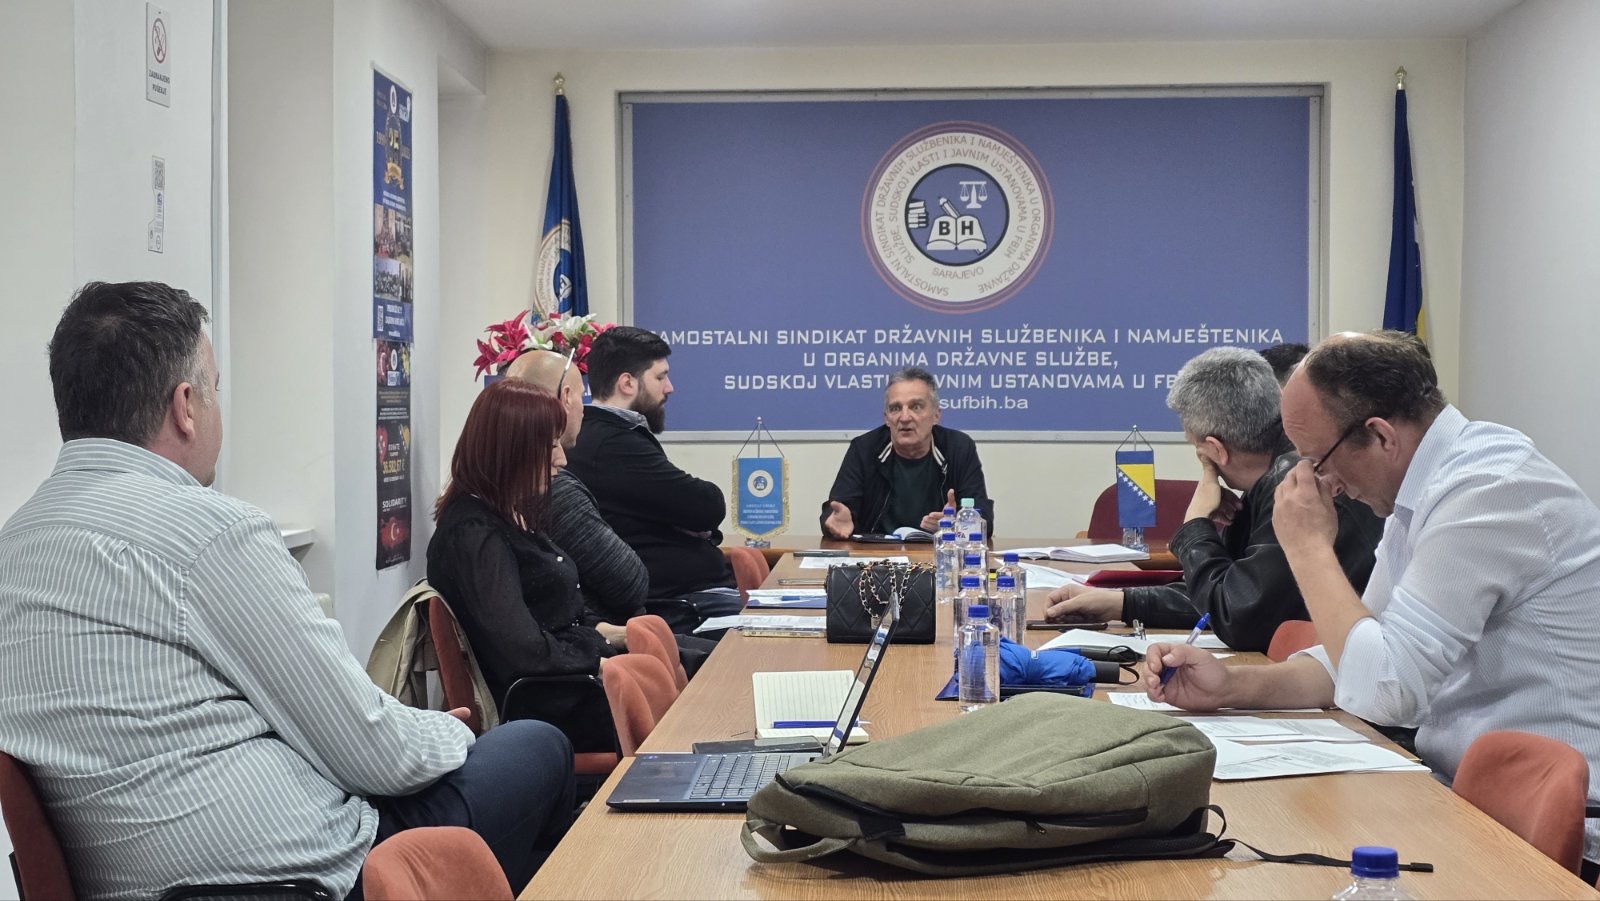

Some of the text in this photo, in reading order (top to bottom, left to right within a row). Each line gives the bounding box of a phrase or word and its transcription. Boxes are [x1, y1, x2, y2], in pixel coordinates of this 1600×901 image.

[903, 134, 967, 161] SLUŽBENIKA
[951, 148, 989, 163] JAVNIM
[905, 150, 940, 177] VLASTI
[978, 136, 1038, 195] NAMJEŠTENIKA
[874, 157, 906, 207] DRŽAVNIH
[989, 158, 1027, 222] USTANOVAMA
[888, 175, 909, 222] SUDSKOJ
[1029, 196, 1039, 204] U
[875, 211, 894, 258] SINDIKAT
[1003, 234, 1023, 260] FBIH
[1017, 208, 1040, 262] ORGANIMA
[890, 258, 948, 296] SAMOSTALNI
[932, 266, 984, 279] SARAJEVO
[976, 261, 1022, 294] DRŽAVNE
[650, 324, 1284, 345] AMOSTALNI SINDIKAT DRŽAVNIH SLUŽBENIKA I NAMJEŠTENIKA
[803, 345, 1118, 369] U ORGANIMA DRŽAVNE SLUŽBE,
[724, 374, 817, 390] SUDSKOJ
[824, 374, 889, 389] VLASTI
[933, 374, 983, 389] VNIM
[990, 374, 1125, 389] USTANOVAMA
[1133, 374, 1145, 389] U
[938, 395, 1029, 410] sufbih.ba
